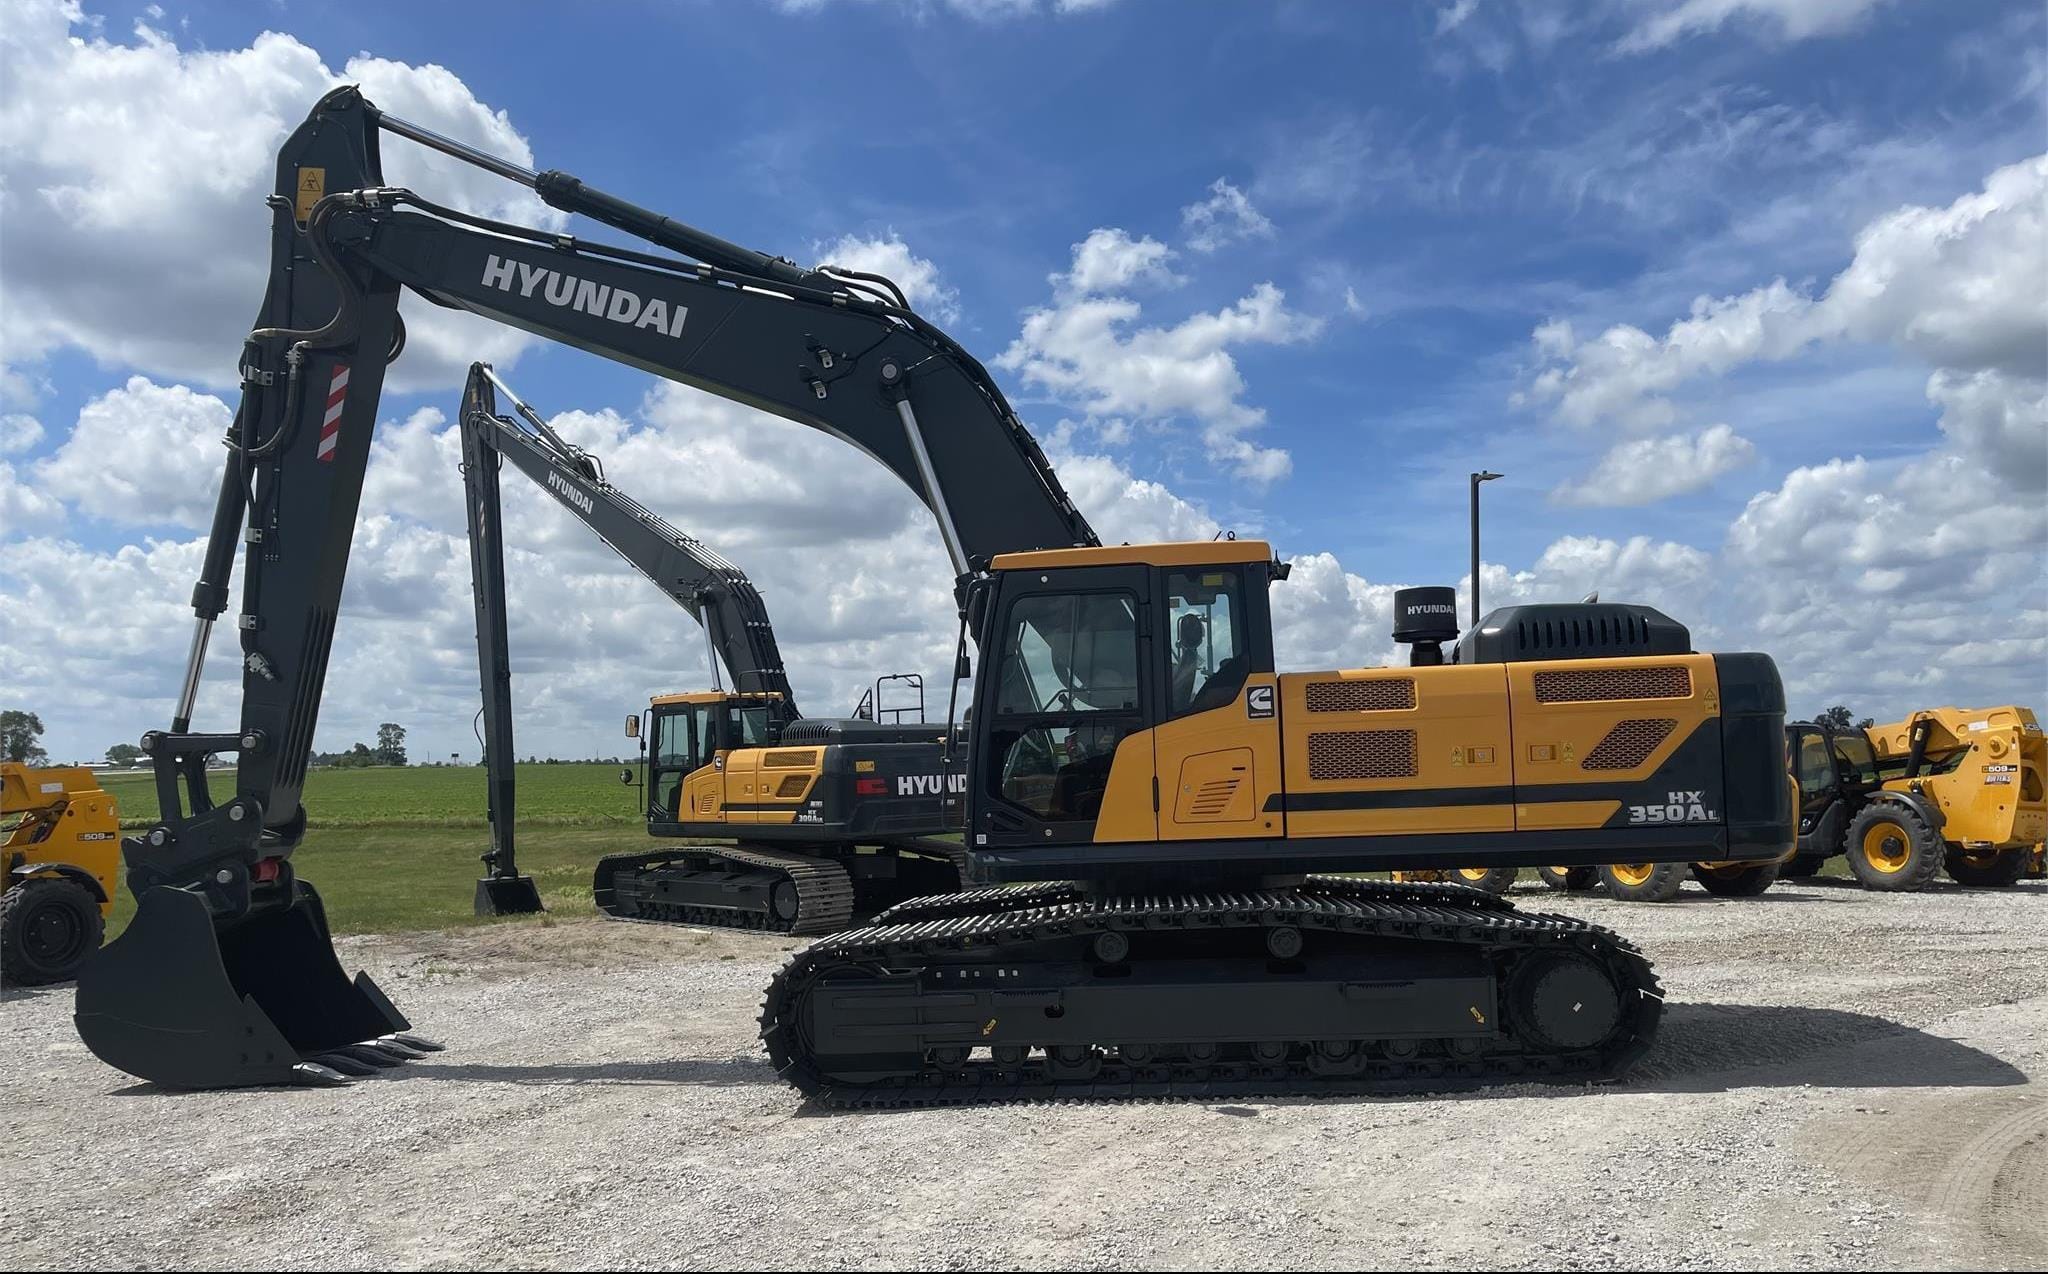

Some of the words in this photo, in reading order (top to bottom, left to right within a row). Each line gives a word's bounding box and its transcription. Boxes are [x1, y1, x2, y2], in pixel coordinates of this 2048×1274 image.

[481, 254, 688, 338] HYUNDAI
[548, 470, 593, 514] HYUNDAI
[1407, 604, 1454, 615] HYUNDAI
[897, 774, 967, 795] HYUND
[1668, 791, 1704, 803] HX
